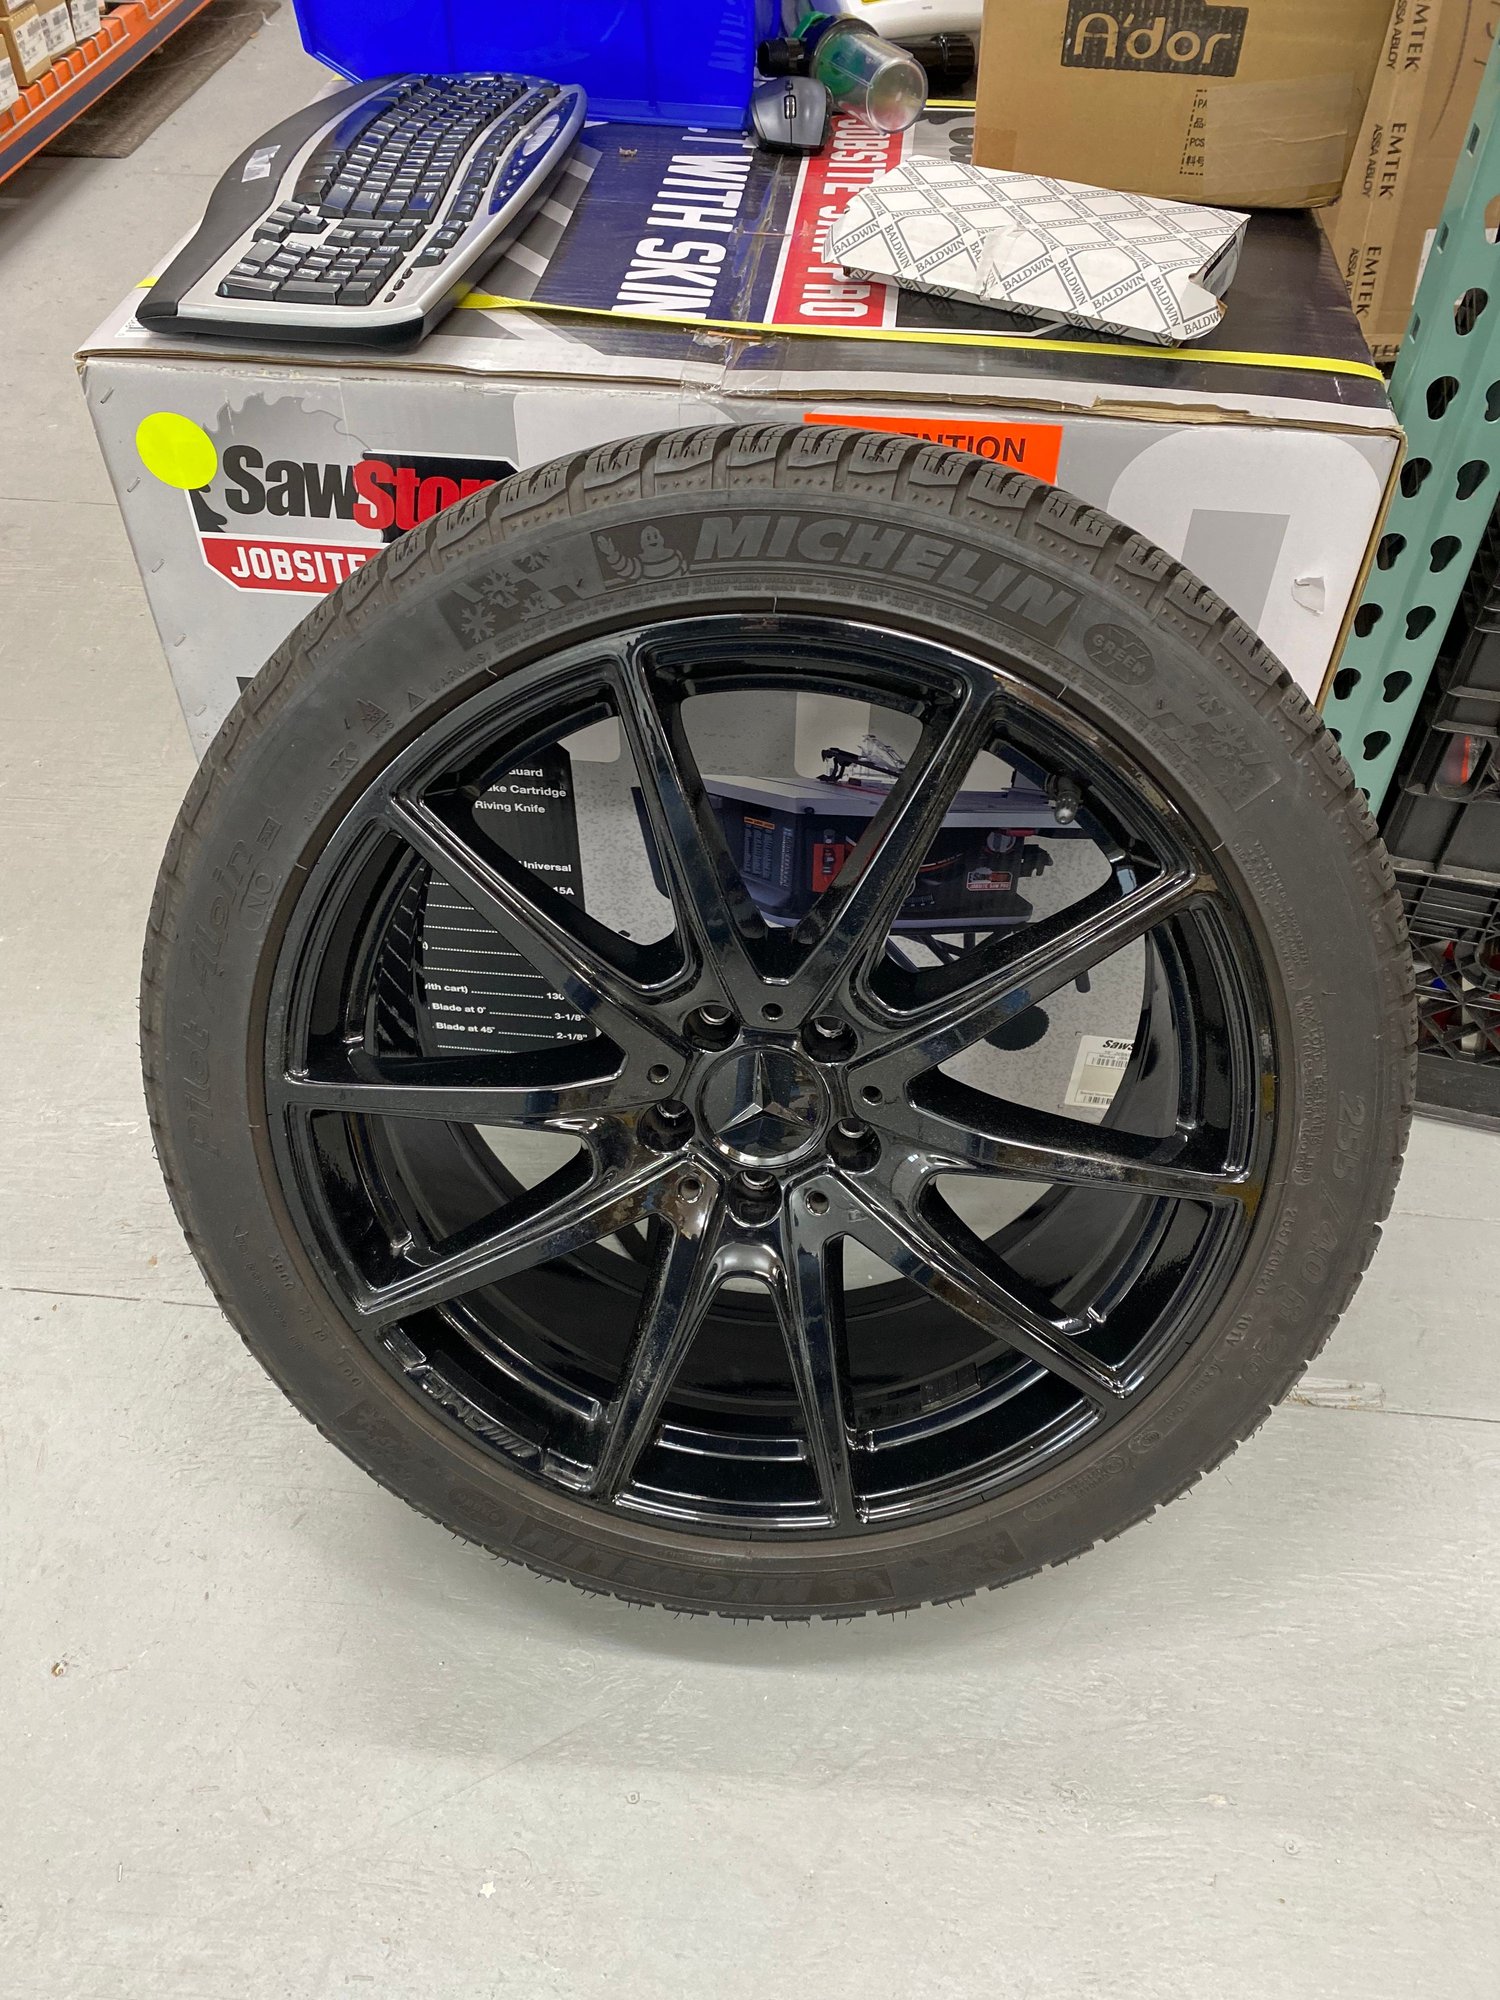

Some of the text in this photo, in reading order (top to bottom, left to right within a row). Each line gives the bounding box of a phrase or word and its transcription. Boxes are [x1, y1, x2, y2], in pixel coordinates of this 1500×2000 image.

[1073, 13, 1232, 64] A'dor
[1386, 0, 1407, 70] SSA ABLOY
[1404, 2, 1431, 72] MTEK
[1362, 123, 1383, 197] ASSA ABLOY
[1379, 122, 1407, 200] EMTEK
[647, 155, 753, 233] WITH
[833, 221, 880, 255] BALDWIN
[884, 224, 912, 269] BALDWIN
[915, 238, 966, 273] BALDWIN
[611, 237, 727, 319] SKIN
[1002, 255, 1053, 291] BALDWIN
[1345, 247, 1359, 278] ASSA
[1058, 258, 1088, 307] BALDWIN
[1092, 273, 1146, 309] BALDWIN
[1150, 276, 1181, 327] BALDWIN
[1356, 246, 1382, 319] EMTEK
[1184, 310, 1223, 335] BALDW
[695, 515, 1077, 628] MICHELIN
[1092, 634, 1146, 677] GREEN
[509, 769, 543, 777] uard
[510, 785, 566, 798] Cartridge
[474, 800, 545, 813] Riving Knife
[432, 1003, 462, 1013] Blade
[444, 984, 468, 994] cart)
[436, 1022, 465, 1032] Blade
[468, 1025, 478, 1033] at
[1103, 1040, 1134, 1050] SawS
